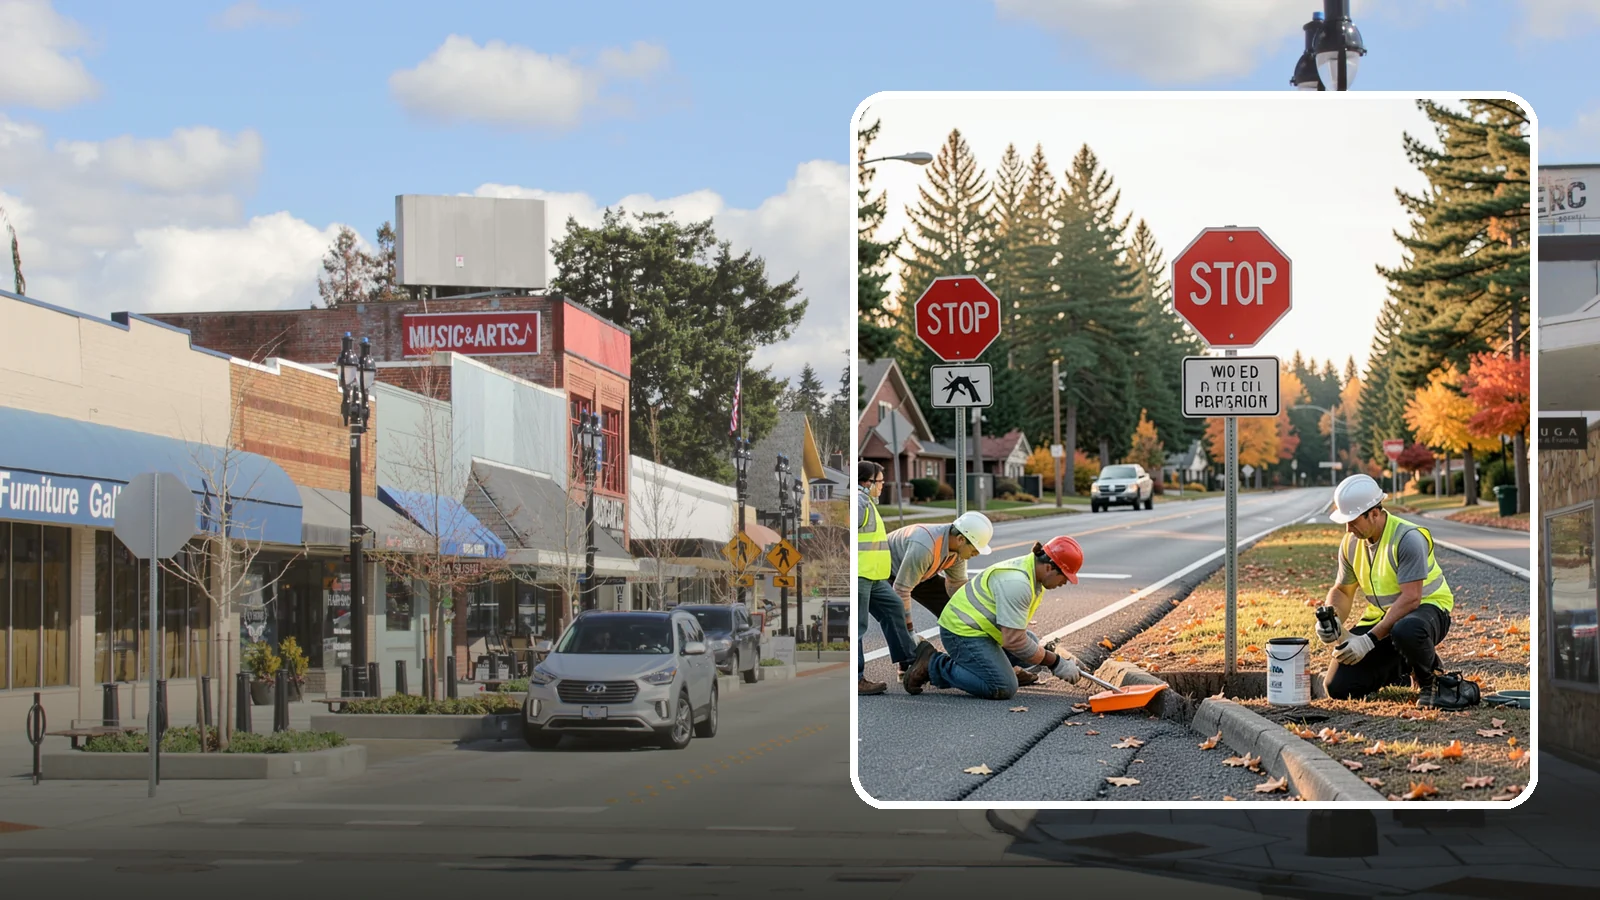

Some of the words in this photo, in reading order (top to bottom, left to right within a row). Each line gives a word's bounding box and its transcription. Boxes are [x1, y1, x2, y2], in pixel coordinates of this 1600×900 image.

[1189, 261, 1277, 306] STOP
[927, 301, 990, 335] STOP
[0, 471, 79, 516] Furniture
